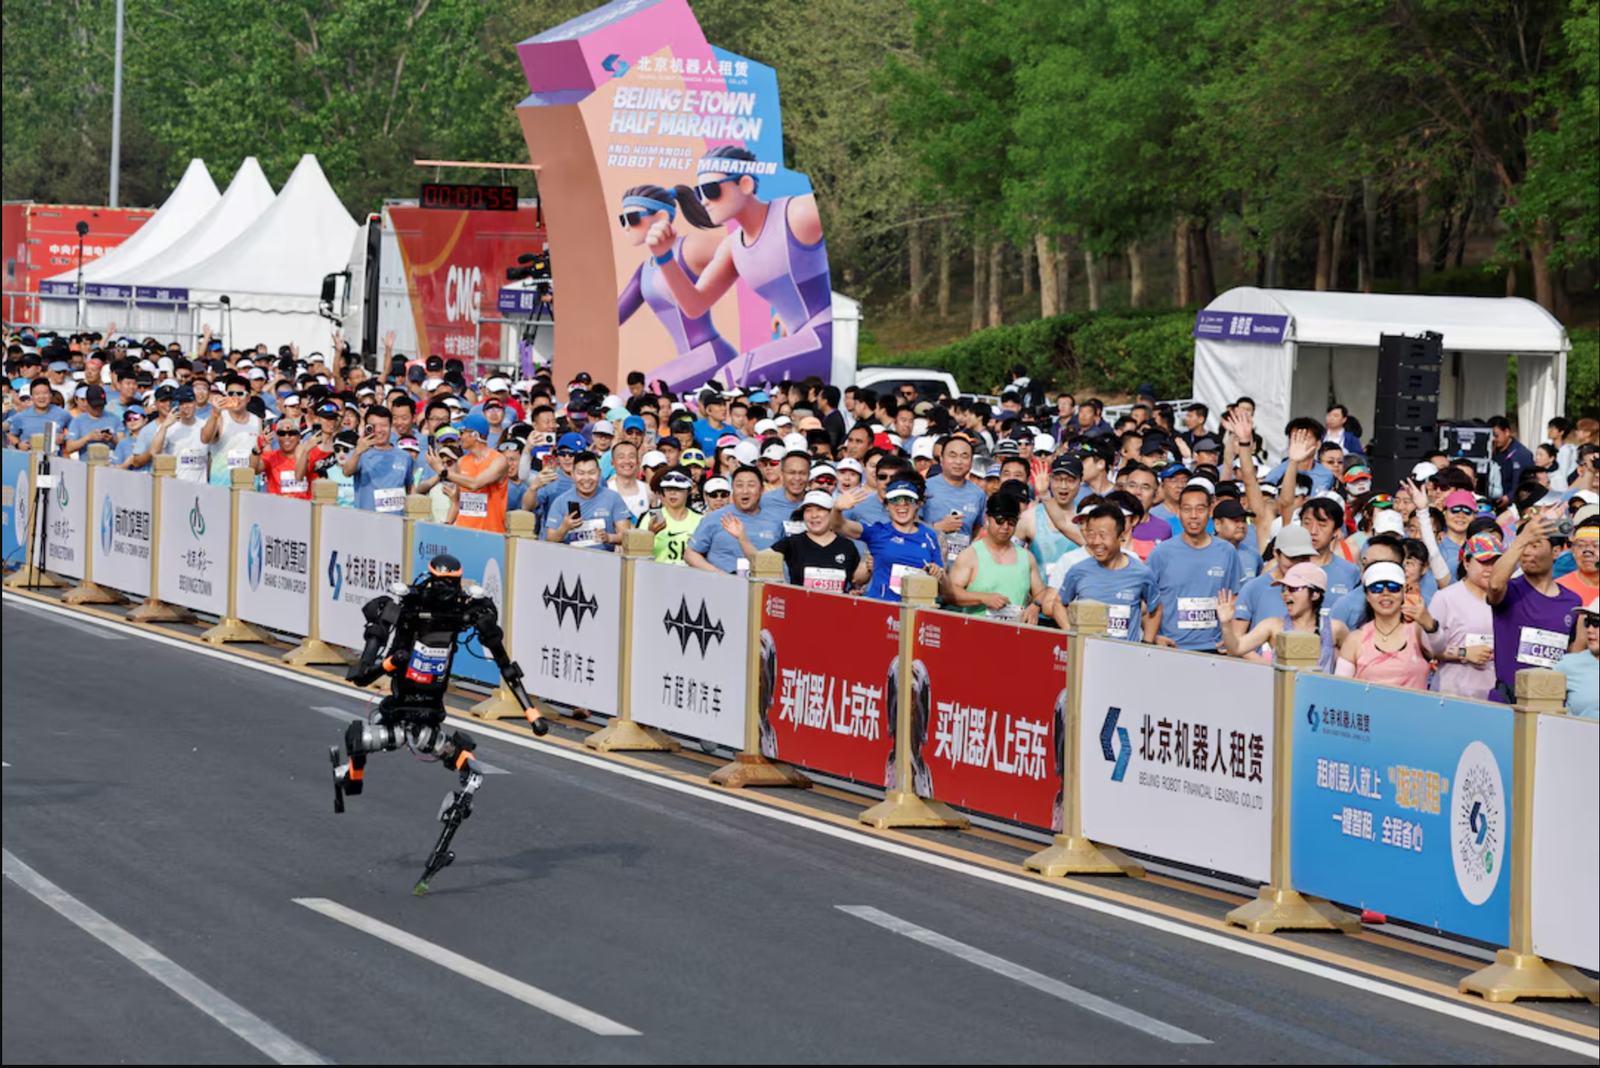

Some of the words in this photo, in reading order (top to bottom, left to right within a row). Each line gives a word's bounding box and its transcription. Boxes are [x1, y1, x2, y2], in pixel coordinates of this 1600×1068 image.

[637, 56, 749, 78] 北京机器人租赁
[613, 86, 683, 112] BEIJING
[682, 89, 756, 116] E-TOWN
[608, 112, 658, 136] HALF
[657, 114, 763, 142] MARATHON
[607, 154, 657, 168] ROBOT
[658, 157, 694, 170] HALF
[696, 158, 778, 175] MARATHON
[632, 145, 692, 158] HUMANOID
[424, 185, 515, 208] 00:00:55
[445, 264, 481, 325] CMG
[540, 645, 595, 687] 方程豹汽车
[662, 672, 722, 718] 方程豹汽车
[779, 667, 884, 742] 买机器人上京东
[1322, 706, 1370, 733] 北京机器人租赁
[934, 700, 1050, 781] 买机器人上京东
[1139, 714, 1264, 784] 北京机器人租赁
[1139, 771, 1160, 788] BEIJING
[1162, 776, 1181, 792] ROBOT
[1183, 780, 1212, 800] FINANCIAL
[1214, 787, 1239, 805] LEASING
[1316, 758, 1382, 800] 租机器人就上
